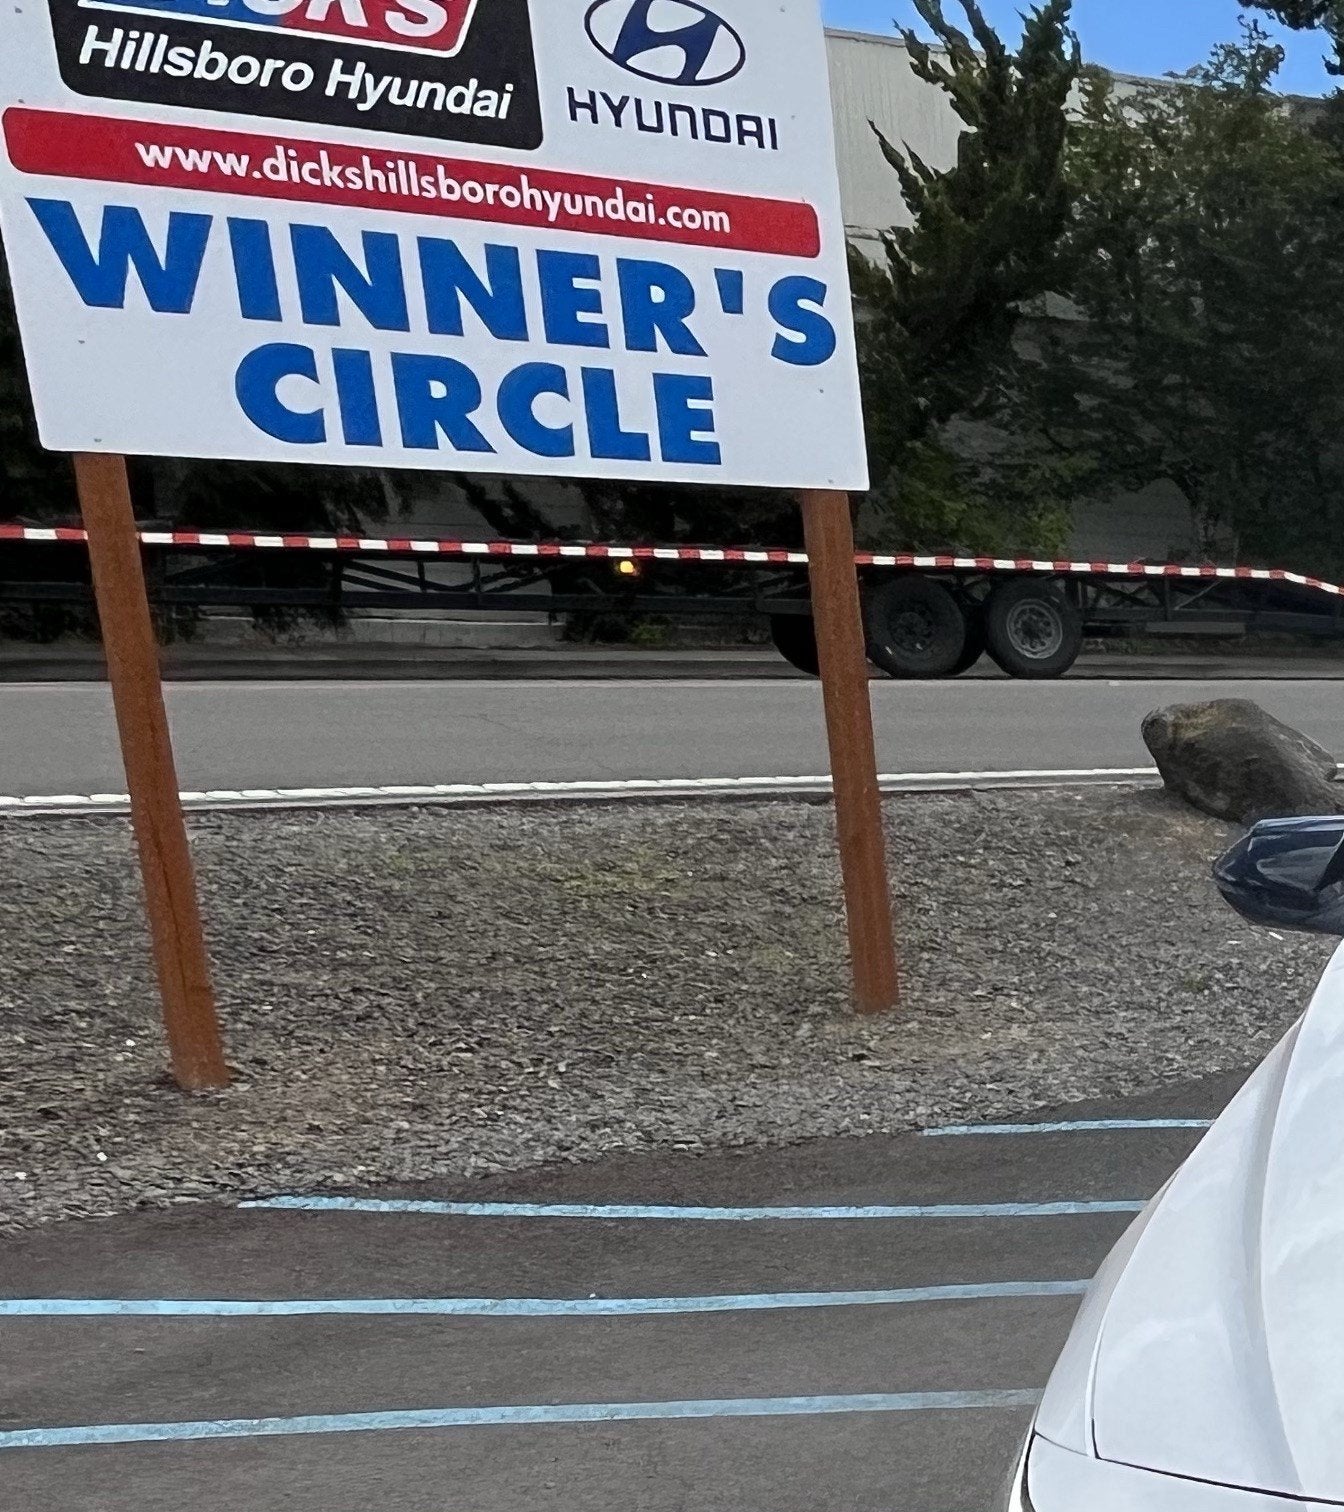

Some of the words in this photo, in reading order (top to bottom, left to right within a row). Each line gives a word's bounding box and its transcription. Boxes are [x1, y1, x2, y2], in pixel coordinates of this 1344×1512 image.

[78, 24, 314, 91] Hillsboro
[324, 58, 515, 120] Hyundai
[566, 86, 779, 150] HYUNDAI
[135, 137, 731, 235] www.dickshillsborohyundai.com
[25, 197, 838, 366] WINNER'S
[234, 341, 722, 466] CIRCLE
